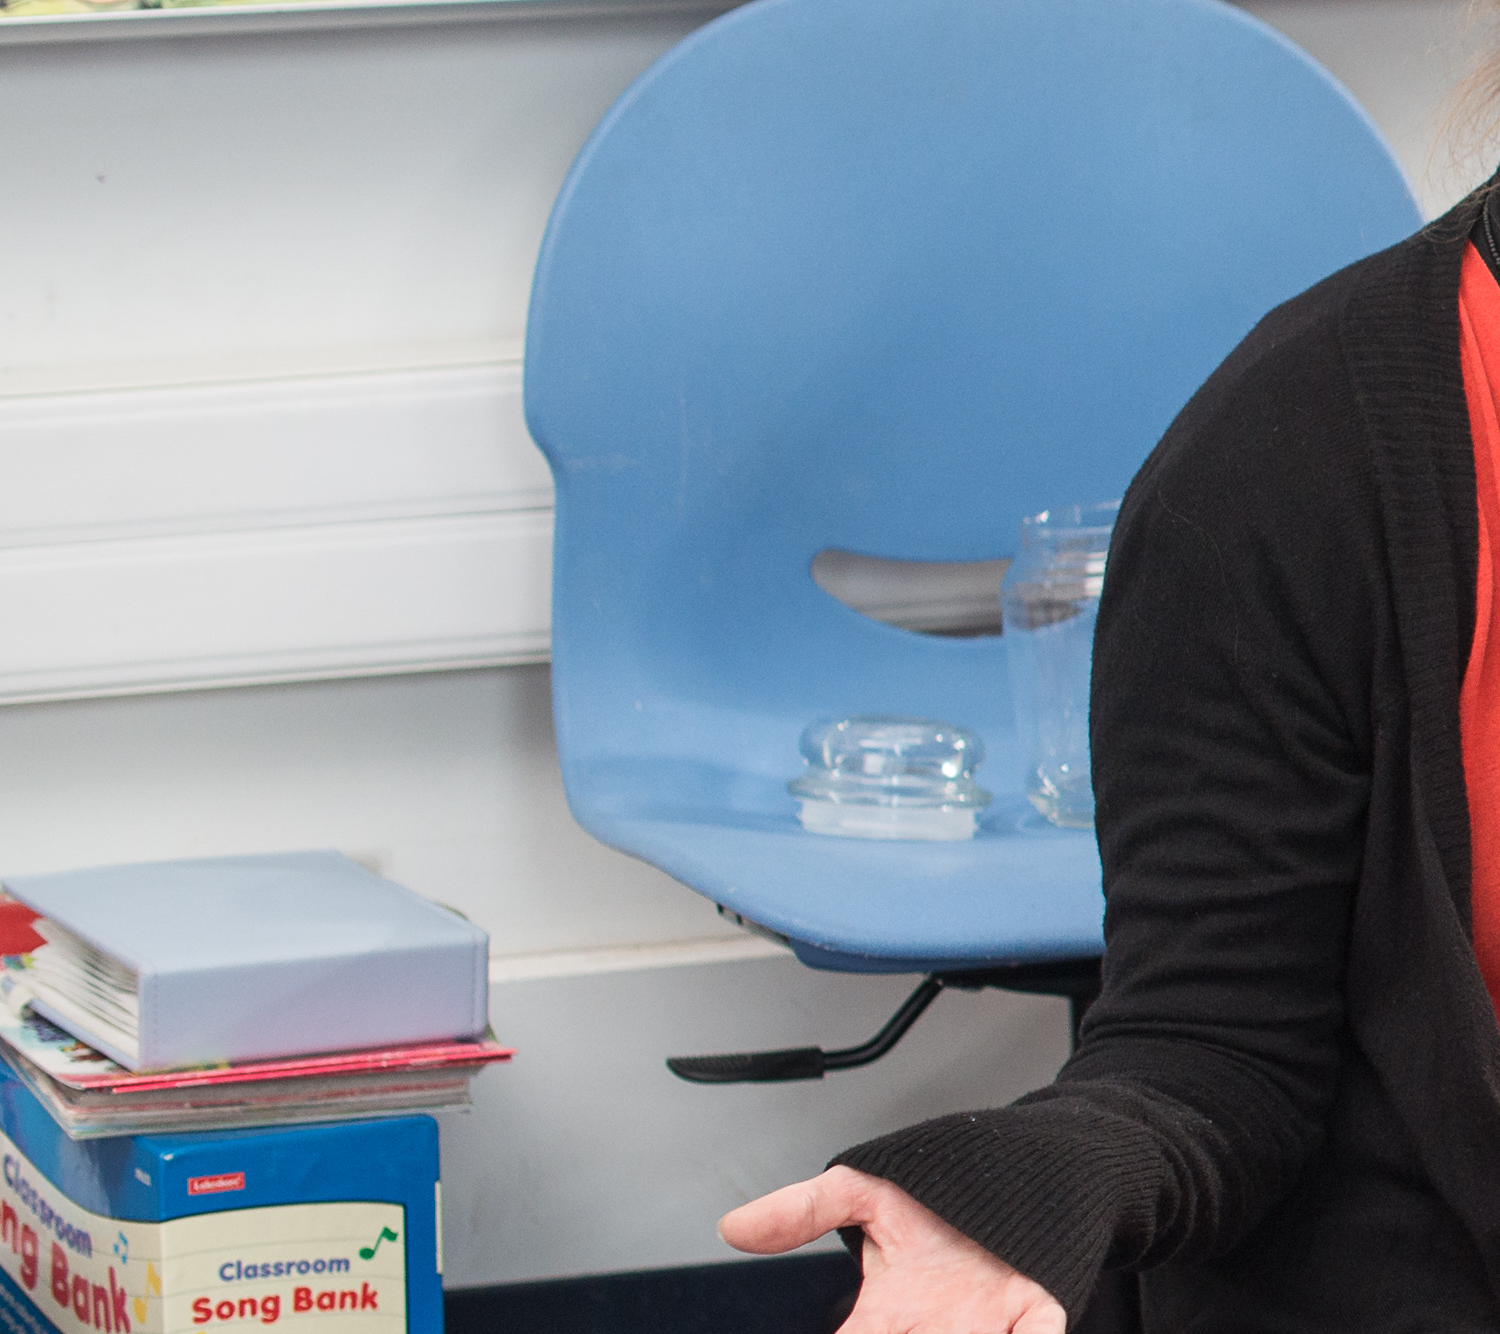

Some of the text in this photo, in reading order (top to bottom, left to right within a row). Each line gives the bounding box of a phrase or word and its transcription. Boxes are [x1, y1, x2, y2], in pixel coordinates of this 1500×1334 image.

[4, 1153, 92, 1258] Classroom
[51, 1239, 131, 1334] Bank
[191, 1281, 378, 1325] Song Bank
[218, 1257, 351, 1281] Classroom
